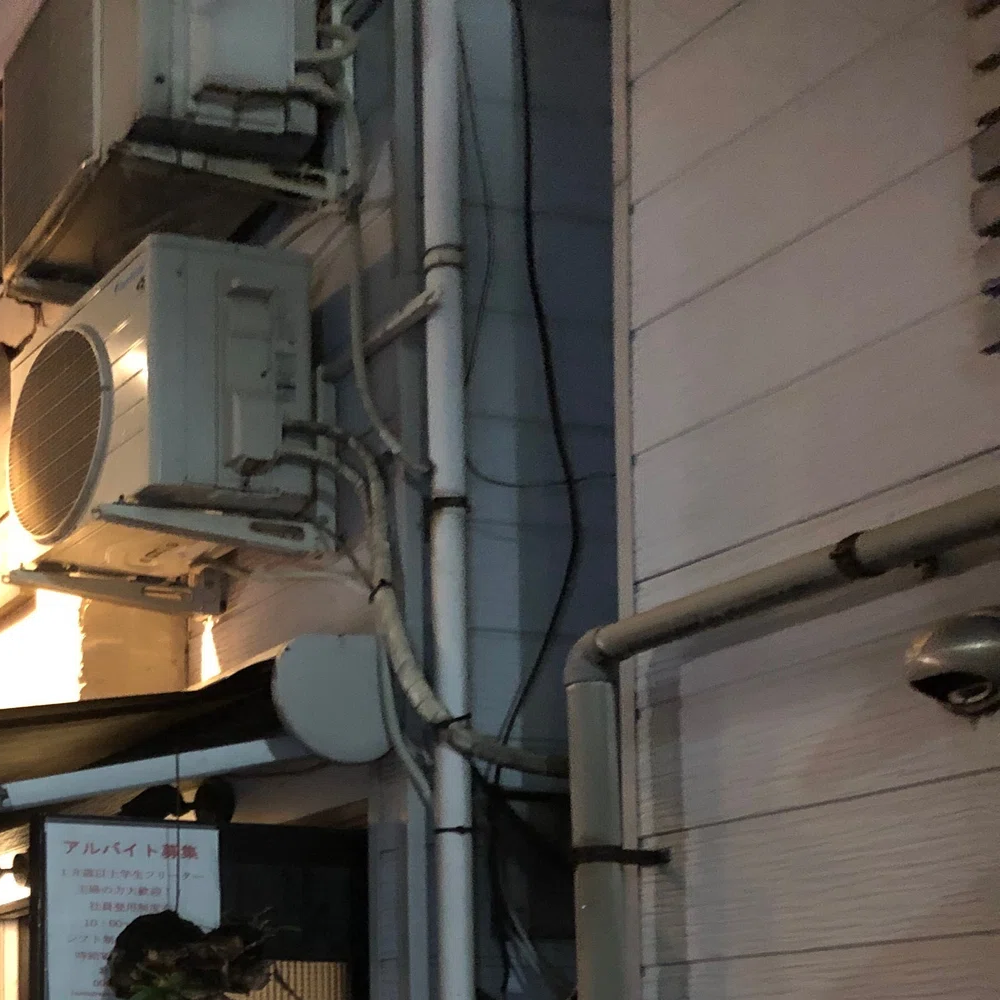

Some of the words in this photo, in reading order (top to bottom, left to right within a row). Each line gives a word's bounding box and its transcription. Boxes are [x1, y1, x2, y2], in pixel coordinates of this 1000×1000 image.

[63, 840, 198, 860] アルバイト募集
